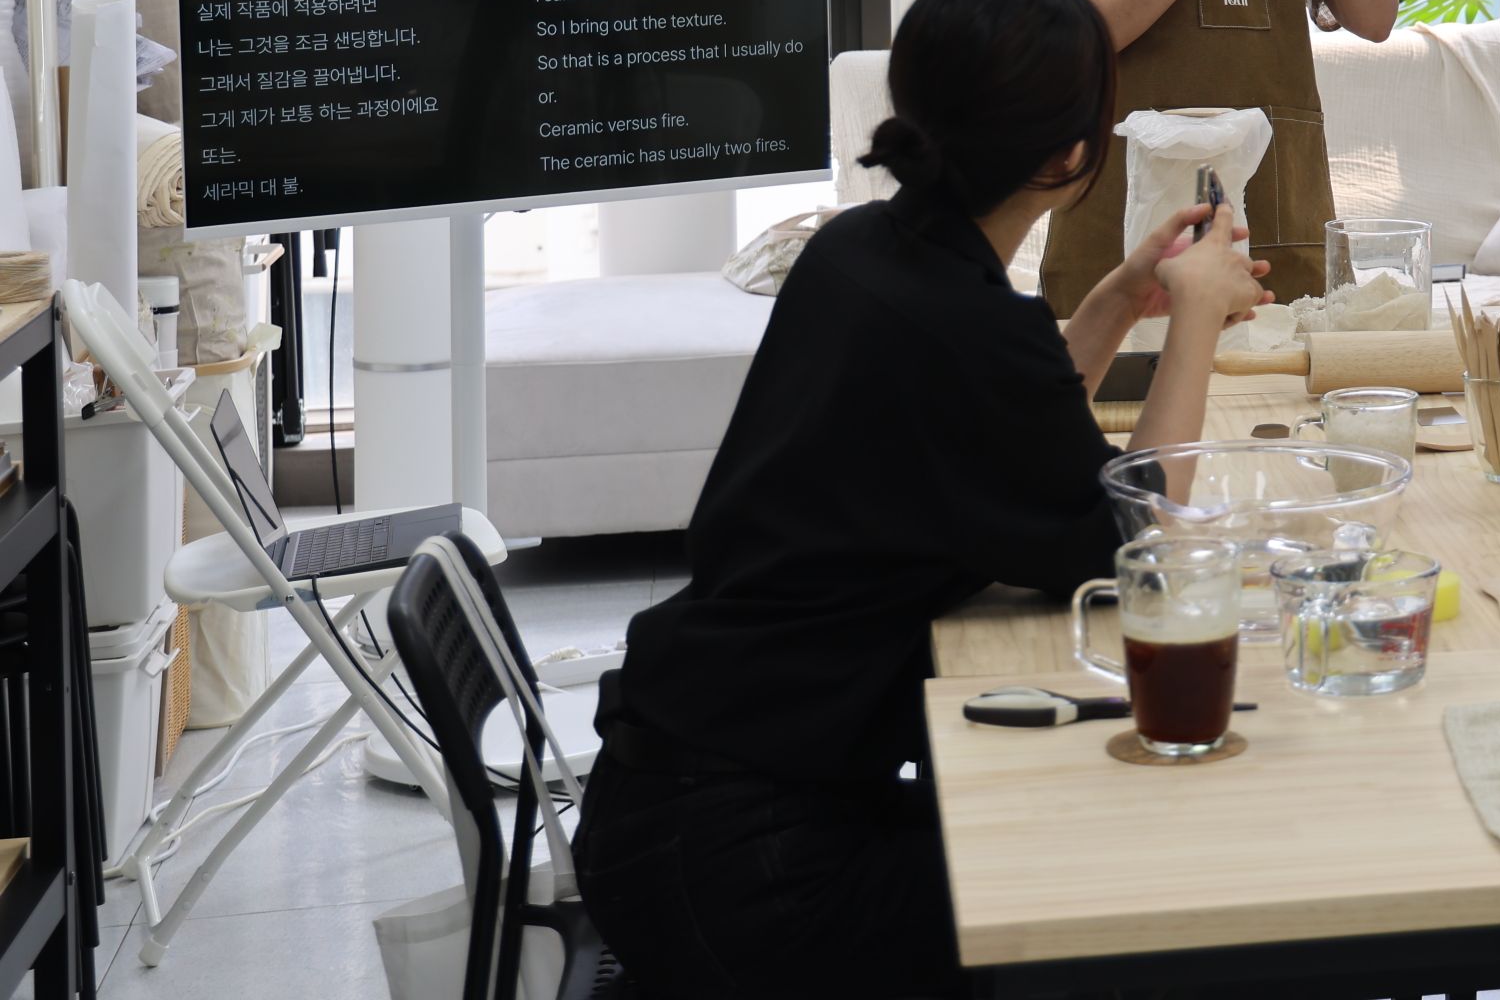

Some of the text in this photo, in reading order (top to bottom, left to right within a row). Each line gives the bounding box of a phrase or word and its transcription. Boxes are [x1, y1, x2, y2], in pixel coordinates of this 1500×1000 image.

[197, 1, 232, 22] 실제
[536, 13, 727, 37] So I bring out the texture.
[198, 27, 421, 57] 나는 그것을 조금 샌딩합니다.
[537, 39, 804, 71] So that is a process that I usually do
[199, 63, 401, 92] 그래서 질감을 끌어냅니다.
[538, 91, 557, 104] or.
[200, 96, 439, 128] 그게 제가 보통 하는 과정이에요
[539, 112, 689, 138] Ceramic versus fire.
[201, 146, 241, 165] 또는.
[539, 137, 790, 172] The ceramic has usually two fires.
[203, 176, 304, 201] 세라믹 대 불.
